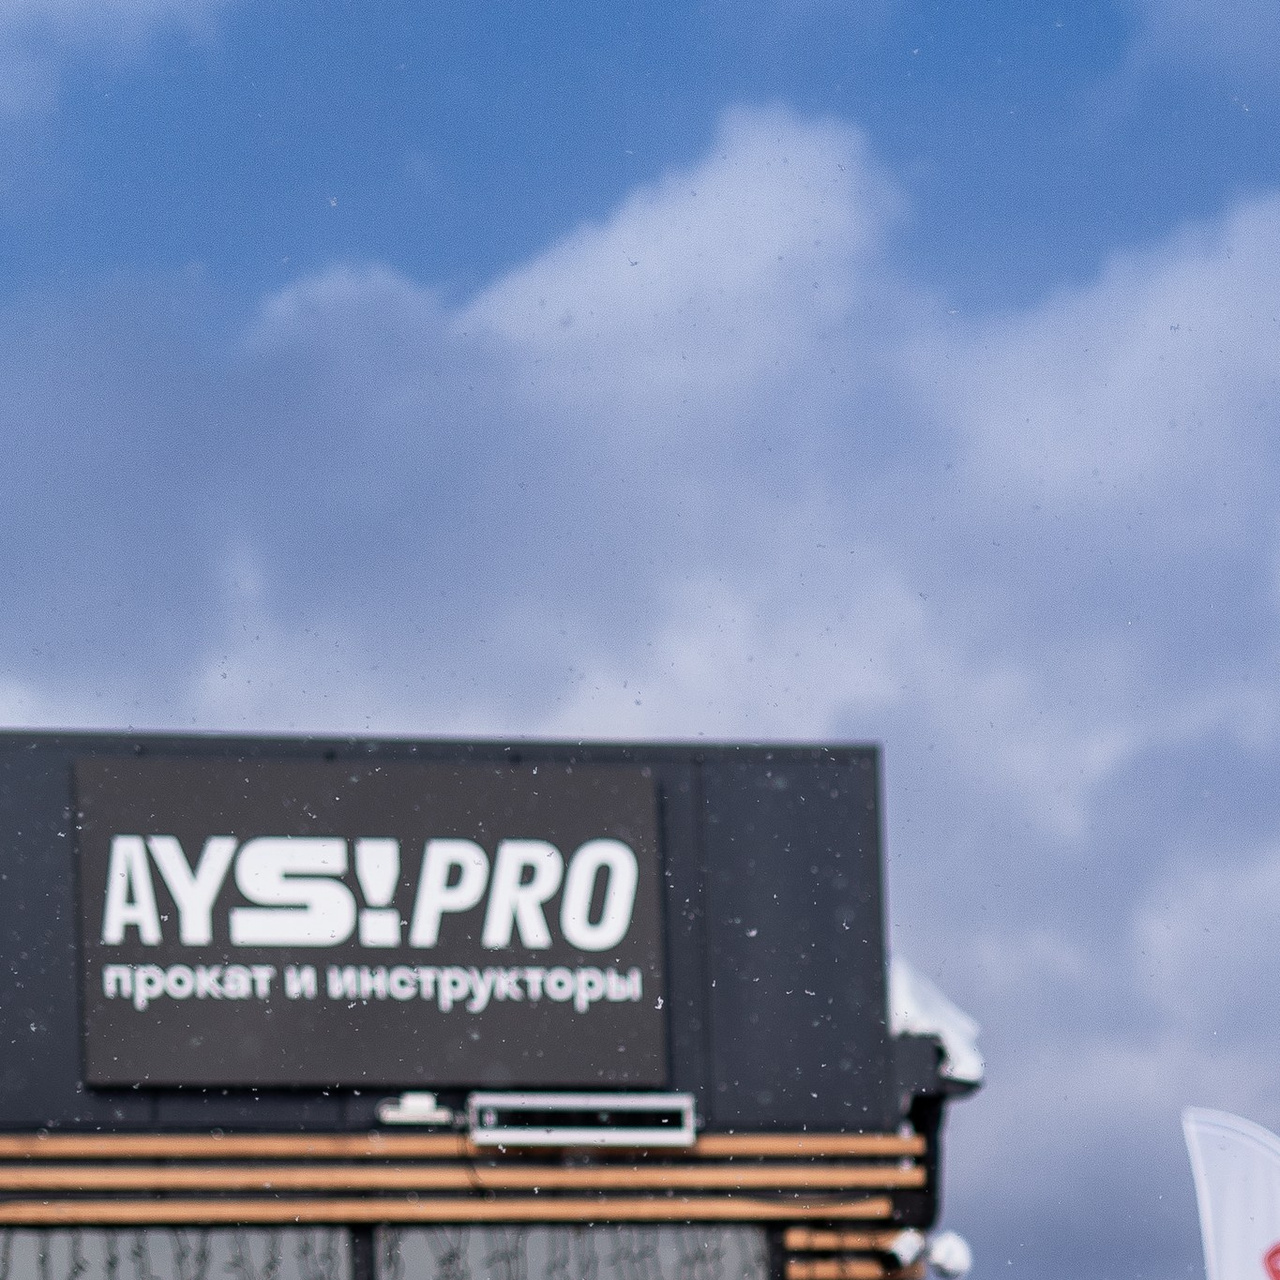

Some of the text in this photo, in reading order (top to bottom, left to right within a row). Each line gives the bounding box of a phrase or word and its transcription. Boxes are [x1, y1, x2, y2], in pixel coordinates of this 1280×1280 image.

[102, 834, 640, 950] AYS!PRO
[103, 963, 642, 1013] прокат и инструкторы
